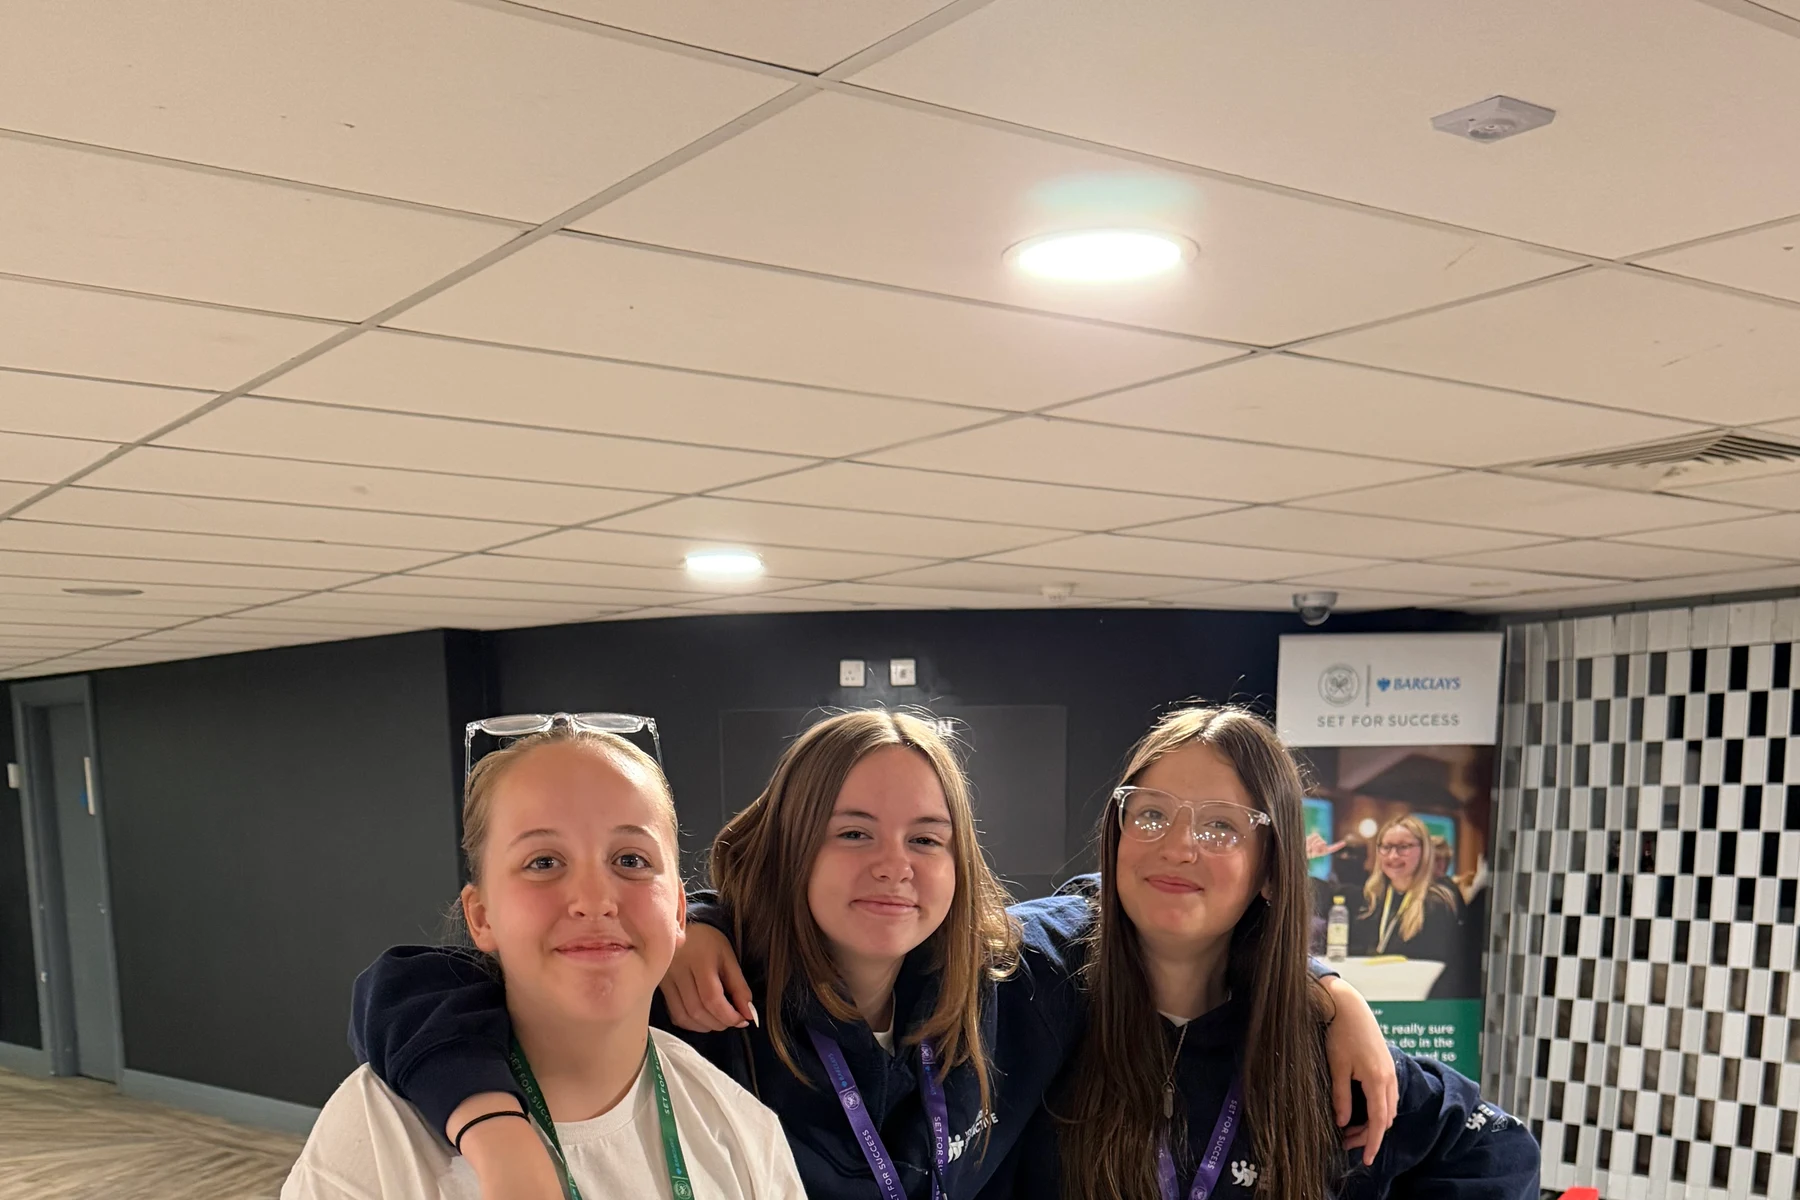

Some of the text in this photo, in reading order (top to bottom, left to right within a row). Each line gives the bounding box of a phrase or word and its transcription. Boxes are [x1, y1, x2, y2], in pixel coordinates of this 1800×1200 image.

[1394, 677, 1461, 690] BARCLAYS
[1317, 714, 1460, 728] SET FOR SUCCESS
[1392, 1023, 1425, 1036] really
[1428, 1024, 1455, 1034] sure
[1399, 1037, 1416, 1048] do
[1419, 1037, 1431, 1048] in
[1434, 1037, 1454, 1048] the
[1441, 1052, 1456, 1062] so
[519, 1074, 533, 1094] FOR
[662, 1096, 671, 1116] SET
[934, 1116, 942, 1132] SET
[1207, 1099, 1238, 1170] SET FOR SUCCESS
[862, 1129, 886, 1170] SUCCESS
[936, 1136, 944, 1156] FOR
[882, 1172, 895, 1192] FOR
